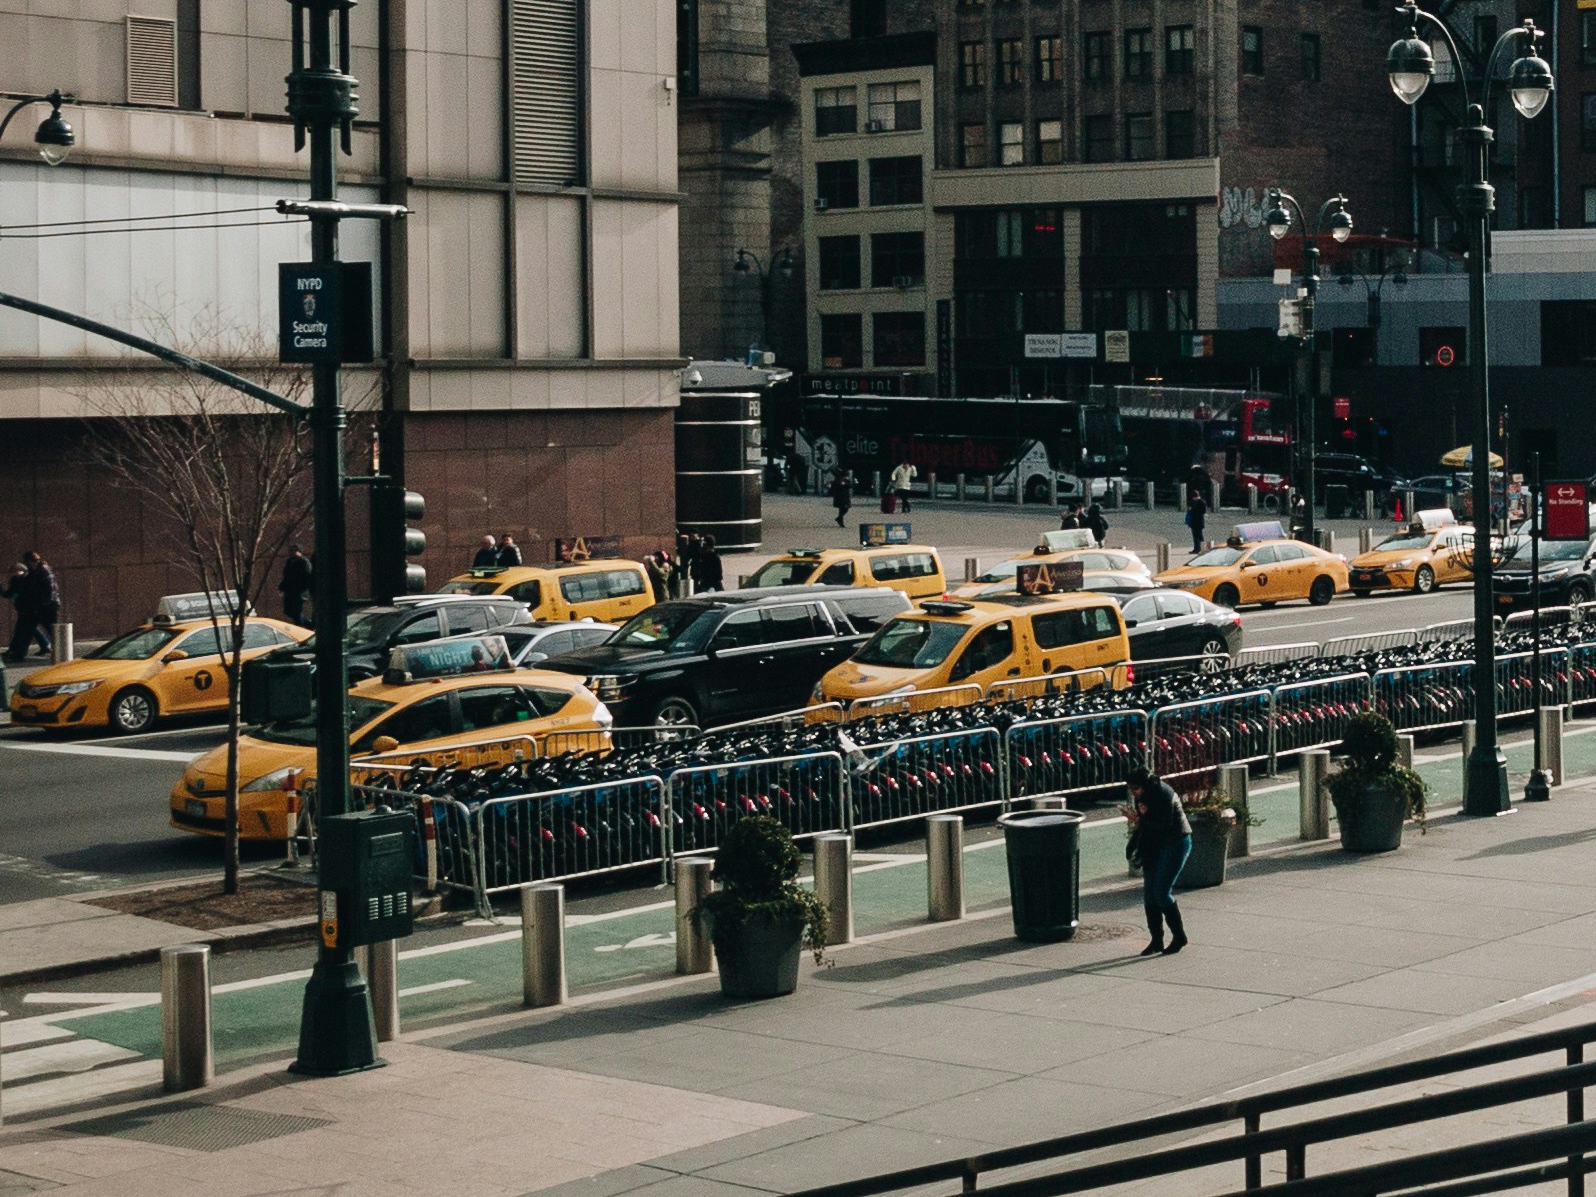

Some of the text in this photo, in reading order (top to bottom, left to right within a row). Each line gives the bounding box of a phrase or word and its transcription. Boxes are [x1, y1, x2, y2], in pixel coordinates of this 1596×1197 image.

[297, 278, 322, 290] NYPD
[293, 321, 328, 335] Security
[294, 336, 327, 347] Camera
[846, 434, 879, 455] elite
[1558, 498, 1583, 506] Standing
